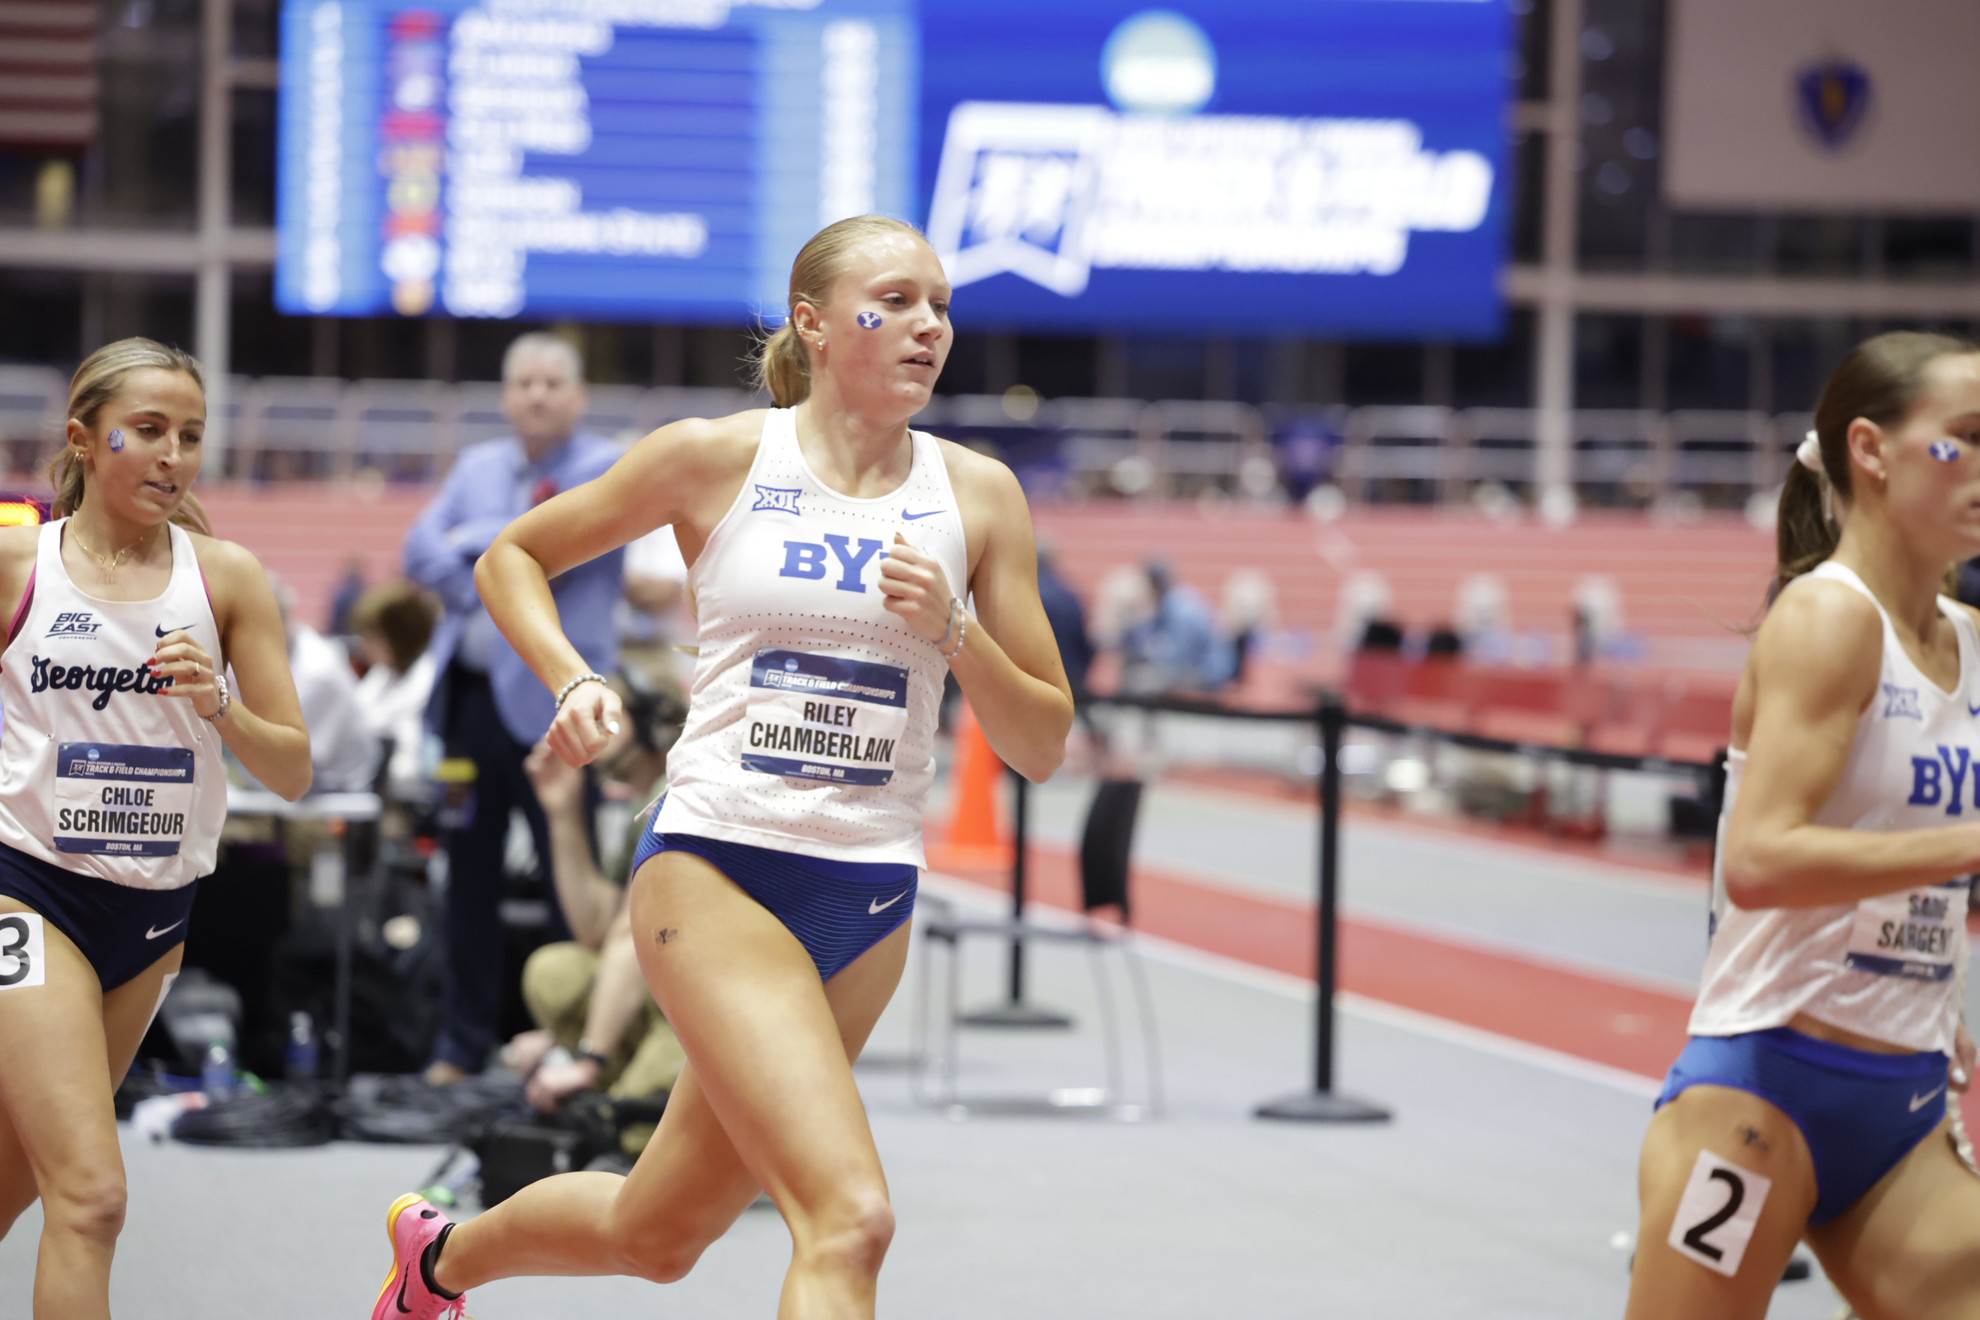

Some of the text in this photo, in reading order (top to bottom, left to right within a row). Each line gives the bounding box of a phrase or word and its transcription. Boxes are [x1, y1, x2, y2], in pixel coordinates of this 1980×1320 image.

[860, 311, 880, 328] Y
[752, 484, 802, 516] XII
[779, 533, 890, 594] BY
[48, 623, 102, 633] EAST
[55, 612, 93, 623] BIG
[782, 676, 807, 687] TRACK
[815, 680, 837, 690] FIELD
[837, 682, 896, 700] CHAMPIONSHIPS
[803, 701, 857, 727] RILEY
[750, 722, 895, 762] CHAMBERLAIN
[85, 764, 109, 774] TRACK
[114, 766, 133, 775] FIELD
[134, 767, 186, 777] CHAMPIONSHIPS
[801, 764, 832, 777] BOSTON,
[832, 768, 845, 778] MA
[101, 787, 155, 806] CHLOE
[58, 808, 184, 835] SCRIMGEOUR
[105, 842, 132, 851] BOSTON,
[1876, 921, 1954, 954] SARGEN
[0, 916, 31, 986] 3
[1683, 1168, 1745, 1262] 2
